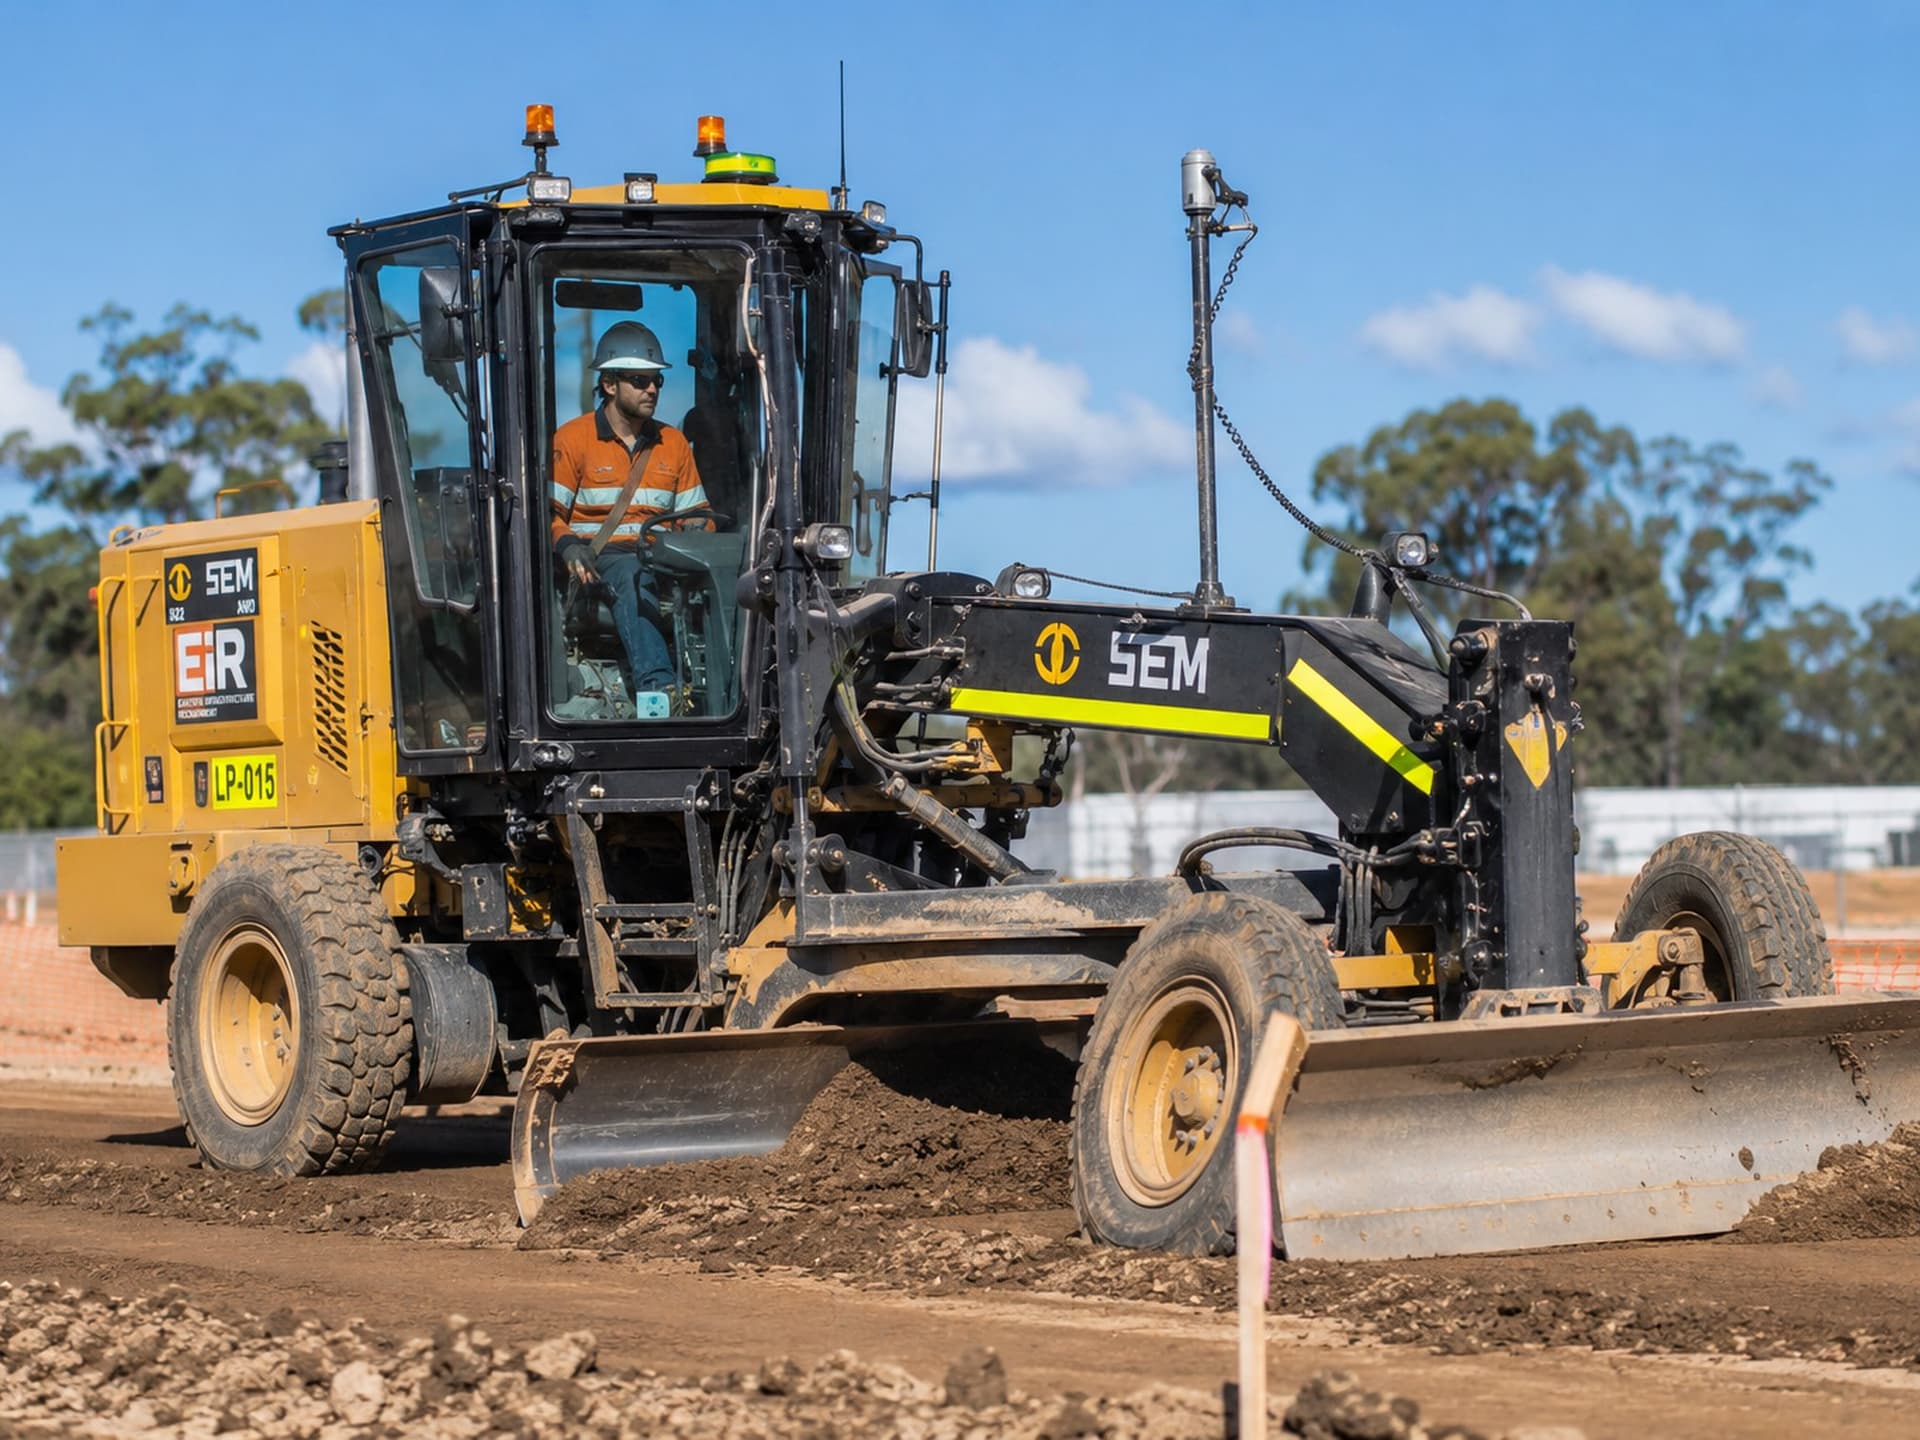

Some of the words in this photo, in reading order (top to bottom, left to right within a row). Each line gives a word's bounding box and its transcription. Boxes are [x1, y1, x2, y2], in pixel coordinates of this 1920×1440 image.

[206, 557, 254, 596] SEM
[1108, 631, 1210, 693] SEM
[215, 763, 275, 801] LP-015
